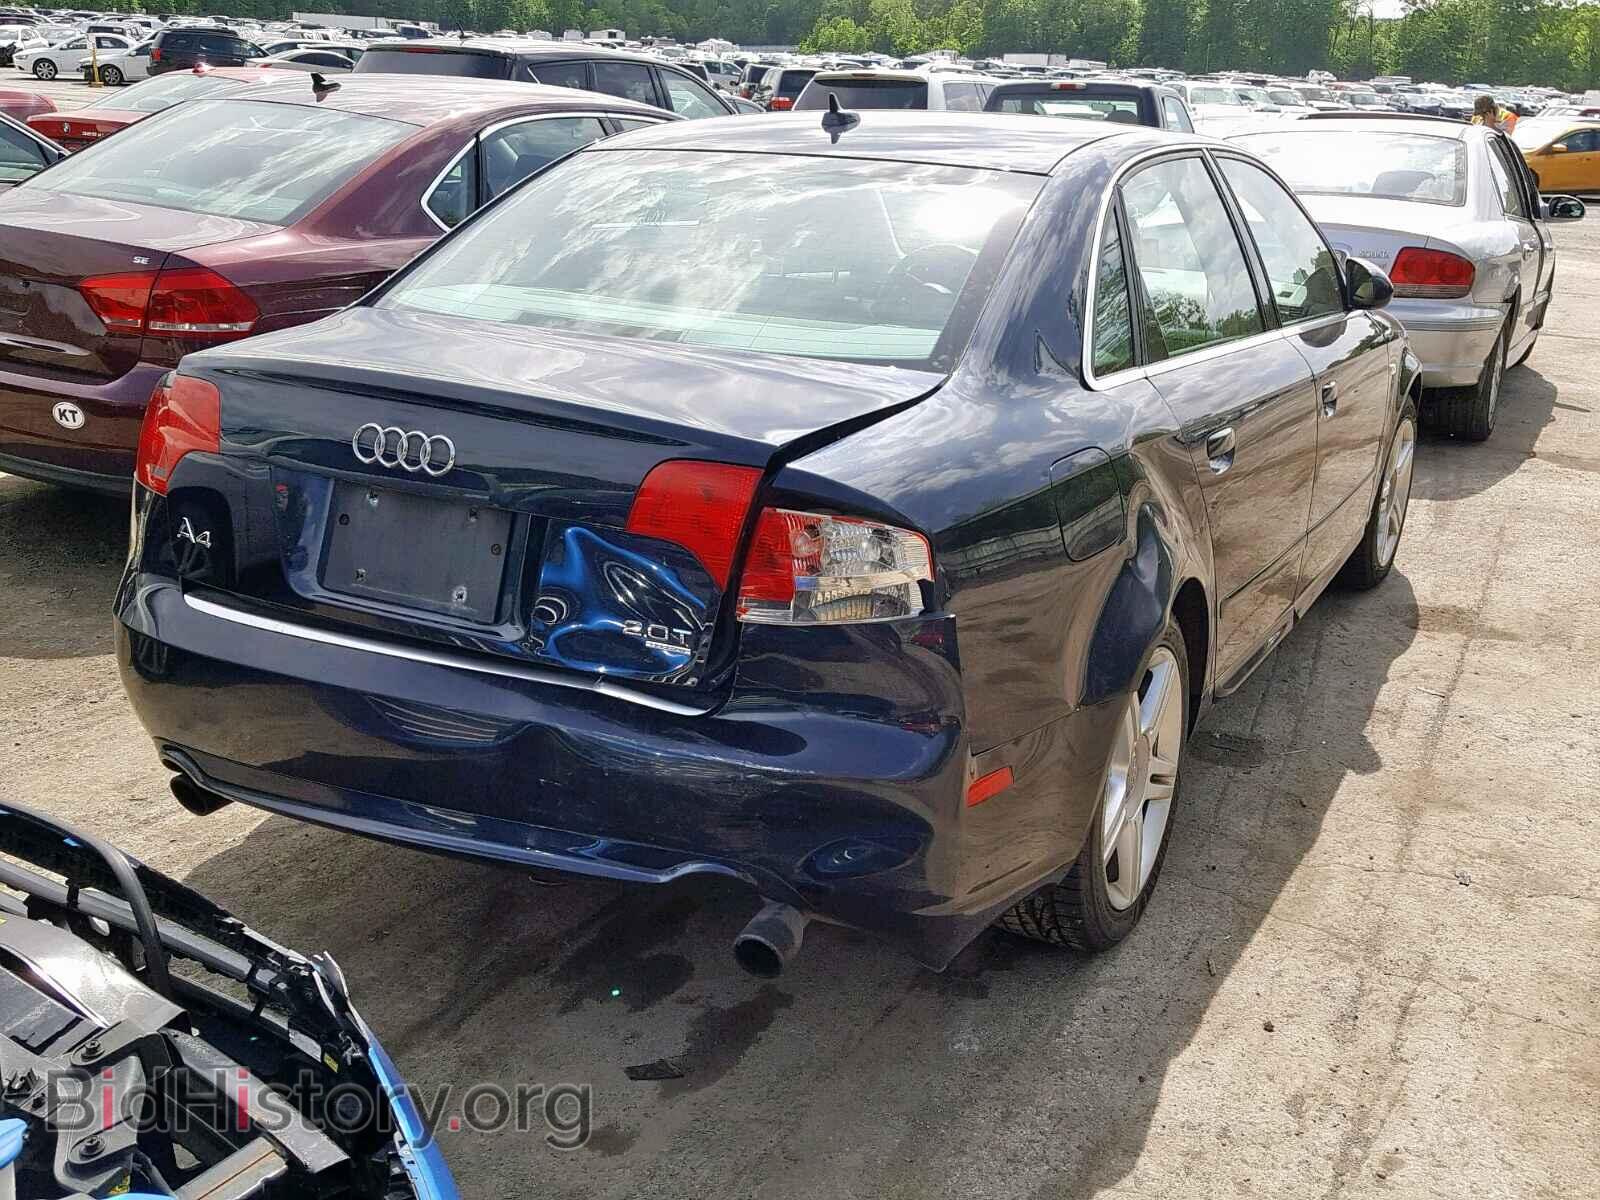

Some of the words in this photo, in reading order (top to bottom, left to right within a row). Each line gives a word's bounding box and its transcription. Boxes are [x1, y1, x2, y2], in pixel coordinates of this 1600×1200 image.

[132, 256, 151, 265] SE
[57, 407, 79, 424] KT
[176, 516, 212, 549] A4
[622, 619, 692, 645] 2.0T
